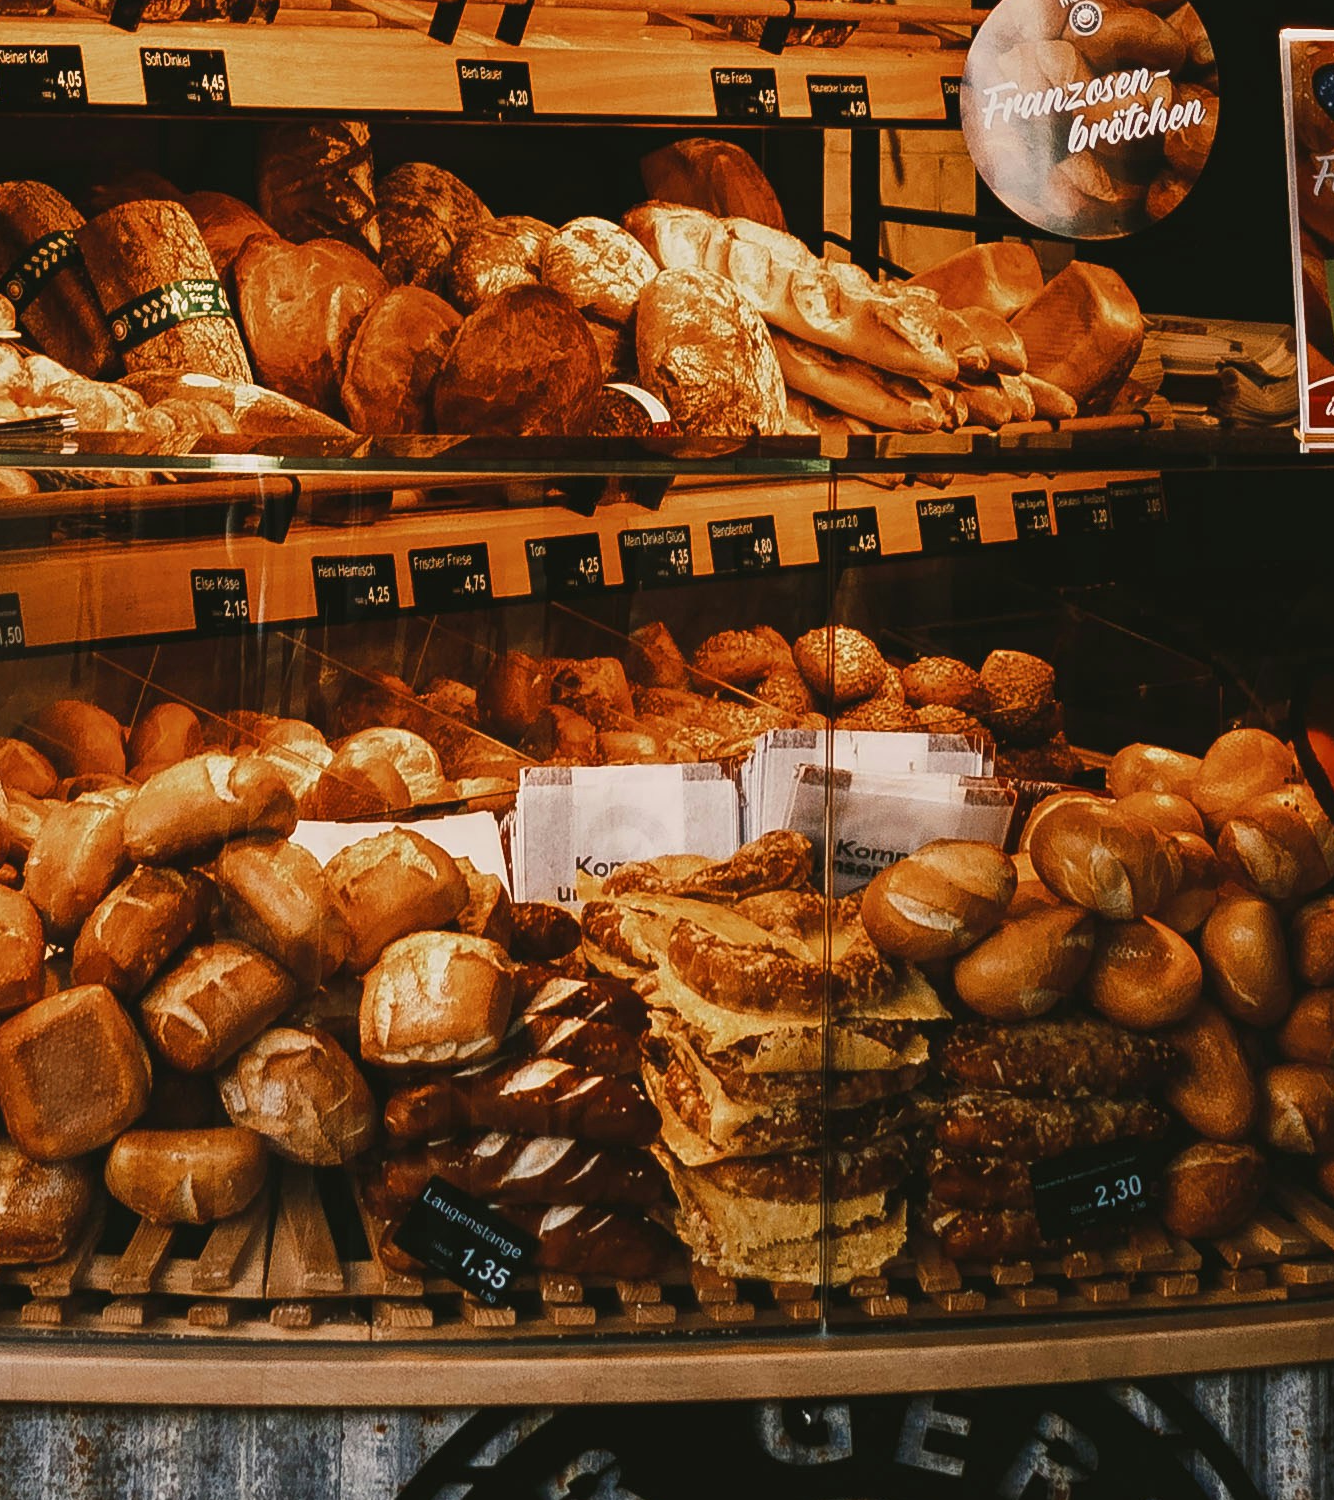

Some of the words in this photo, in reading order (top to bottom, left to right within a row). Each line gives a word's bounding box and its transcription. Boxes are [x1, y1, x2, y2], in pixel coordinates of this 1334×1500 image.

[29, 49, 49, 64] Karl
[144, 51, 162, 66] Soft
[163, 52, 191, 67] Dinkel
[57, 70, 82, 90] 4,05
[202, 73, 225, 93] 4,45
[509, 89, 528, 107] 4,20
[982, 67, 1170, 130] Franzosen-
[1067, 97, 1206, 153] brötchen
[960, 517, 977, 534] 3,15
[754, 537, 773, 555] 4,80
[858, 534, 876, 552] 4,25
[414, 555, 445, 570] Frischer
[579, 556, 599, 576] 4,25
[670, 549, 689, 567] 4,35
[464, 574, 486, 595] 4,75
[368, 586, 390, 605] 4,25
[223, 600, 248, 619] 2,15
[1094, 1174, 1142, 1208] 2,30
[423, 1187, 522, 1259] Laugenstange
[460, 1248, 511, 1289] 1,35
